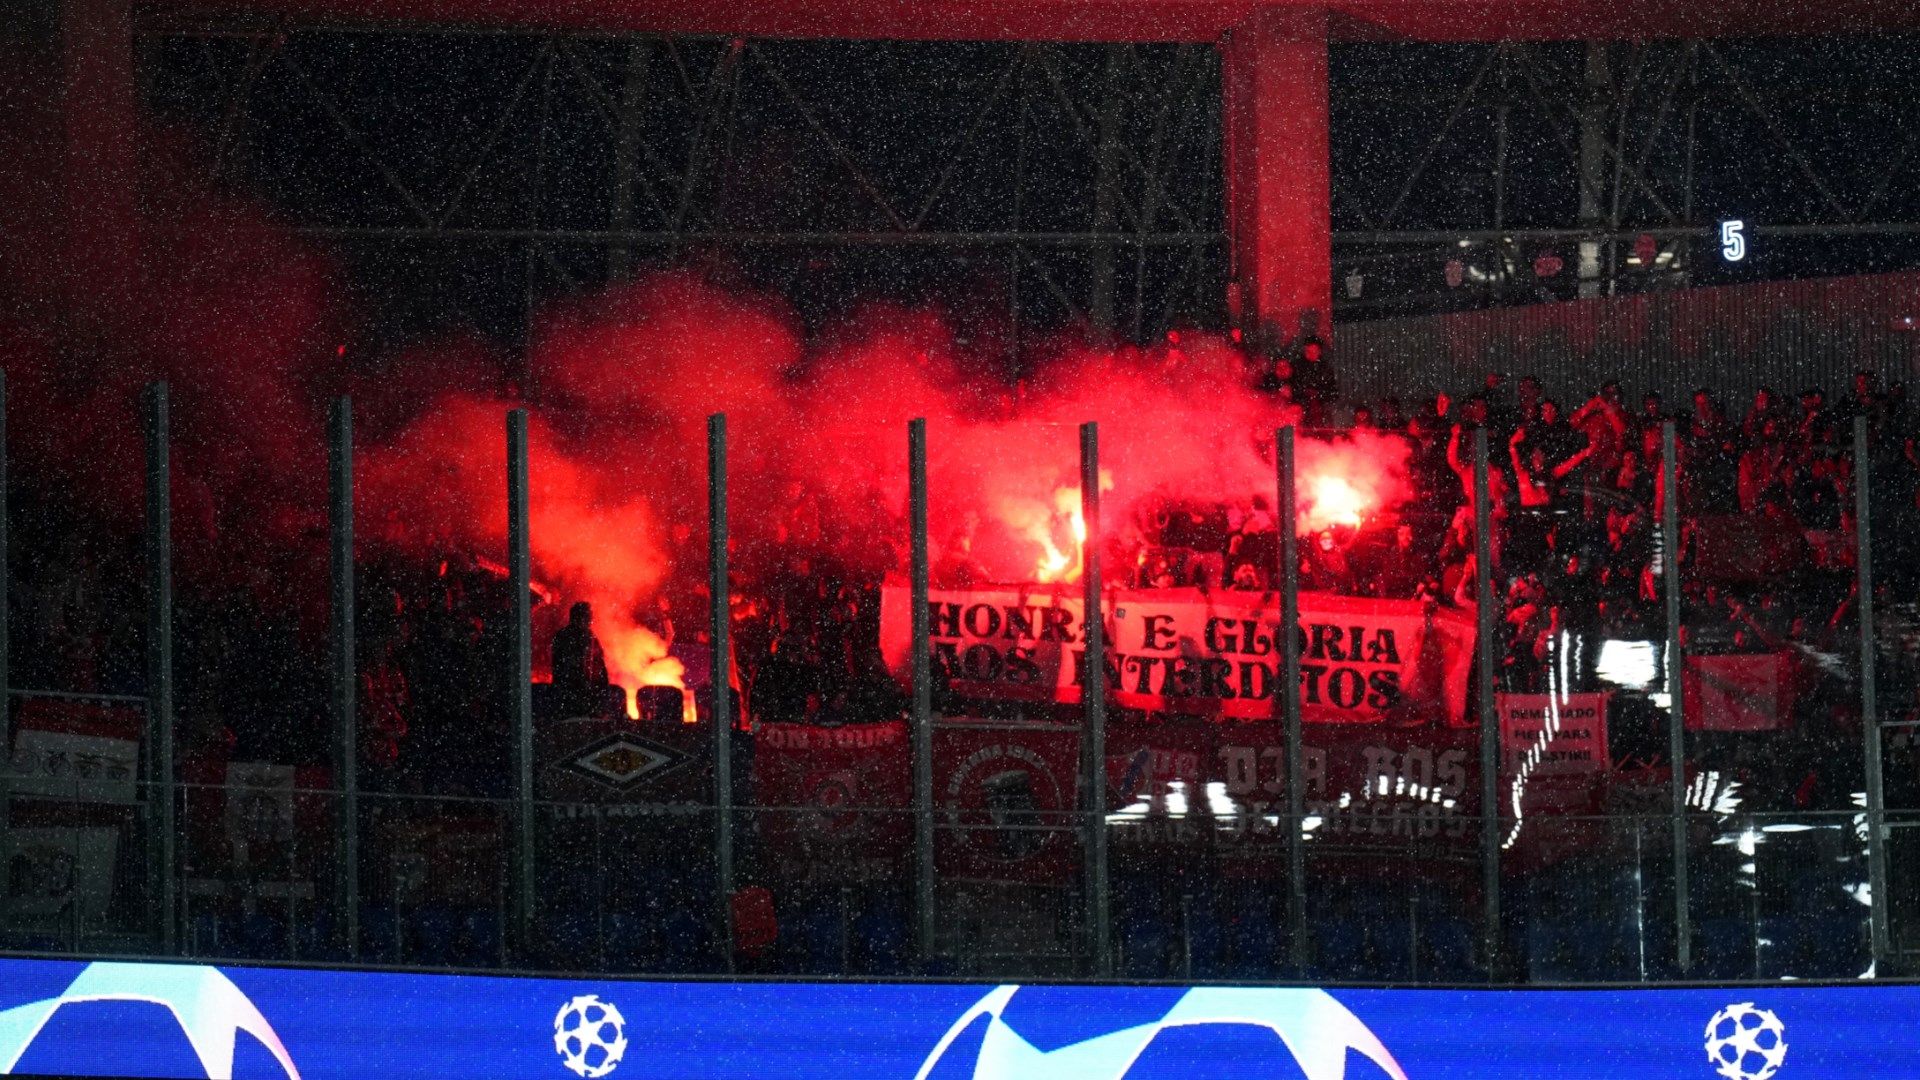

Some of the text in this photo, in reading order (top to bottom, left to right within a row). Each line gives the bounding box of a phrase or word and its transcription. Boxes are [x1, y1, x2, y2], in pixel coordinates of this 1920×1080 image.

[1722, 220, 1745, 261] 5
[1142, 614, 1177, 651] E
[1072, 650, 1401, 709] INTERDTOS
